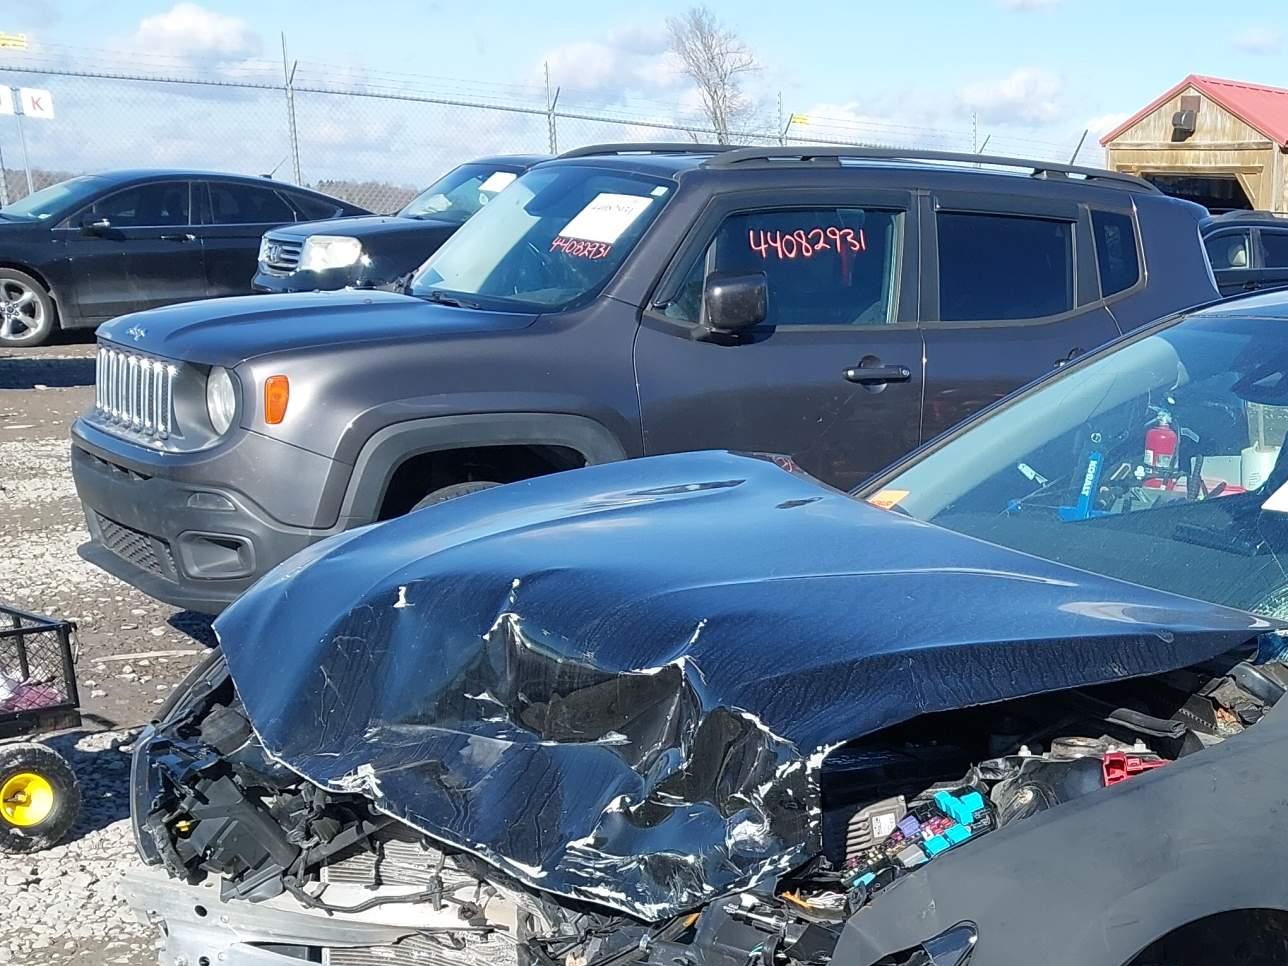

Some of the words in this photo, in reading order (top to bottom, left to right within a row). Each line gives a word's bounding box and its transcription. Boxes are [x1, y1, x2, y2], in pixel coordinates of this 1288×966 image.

[30, 95, 45, 112] K
[549, 236, 612, 260] 44082931
[748, 226, 867, 259] 44082931
